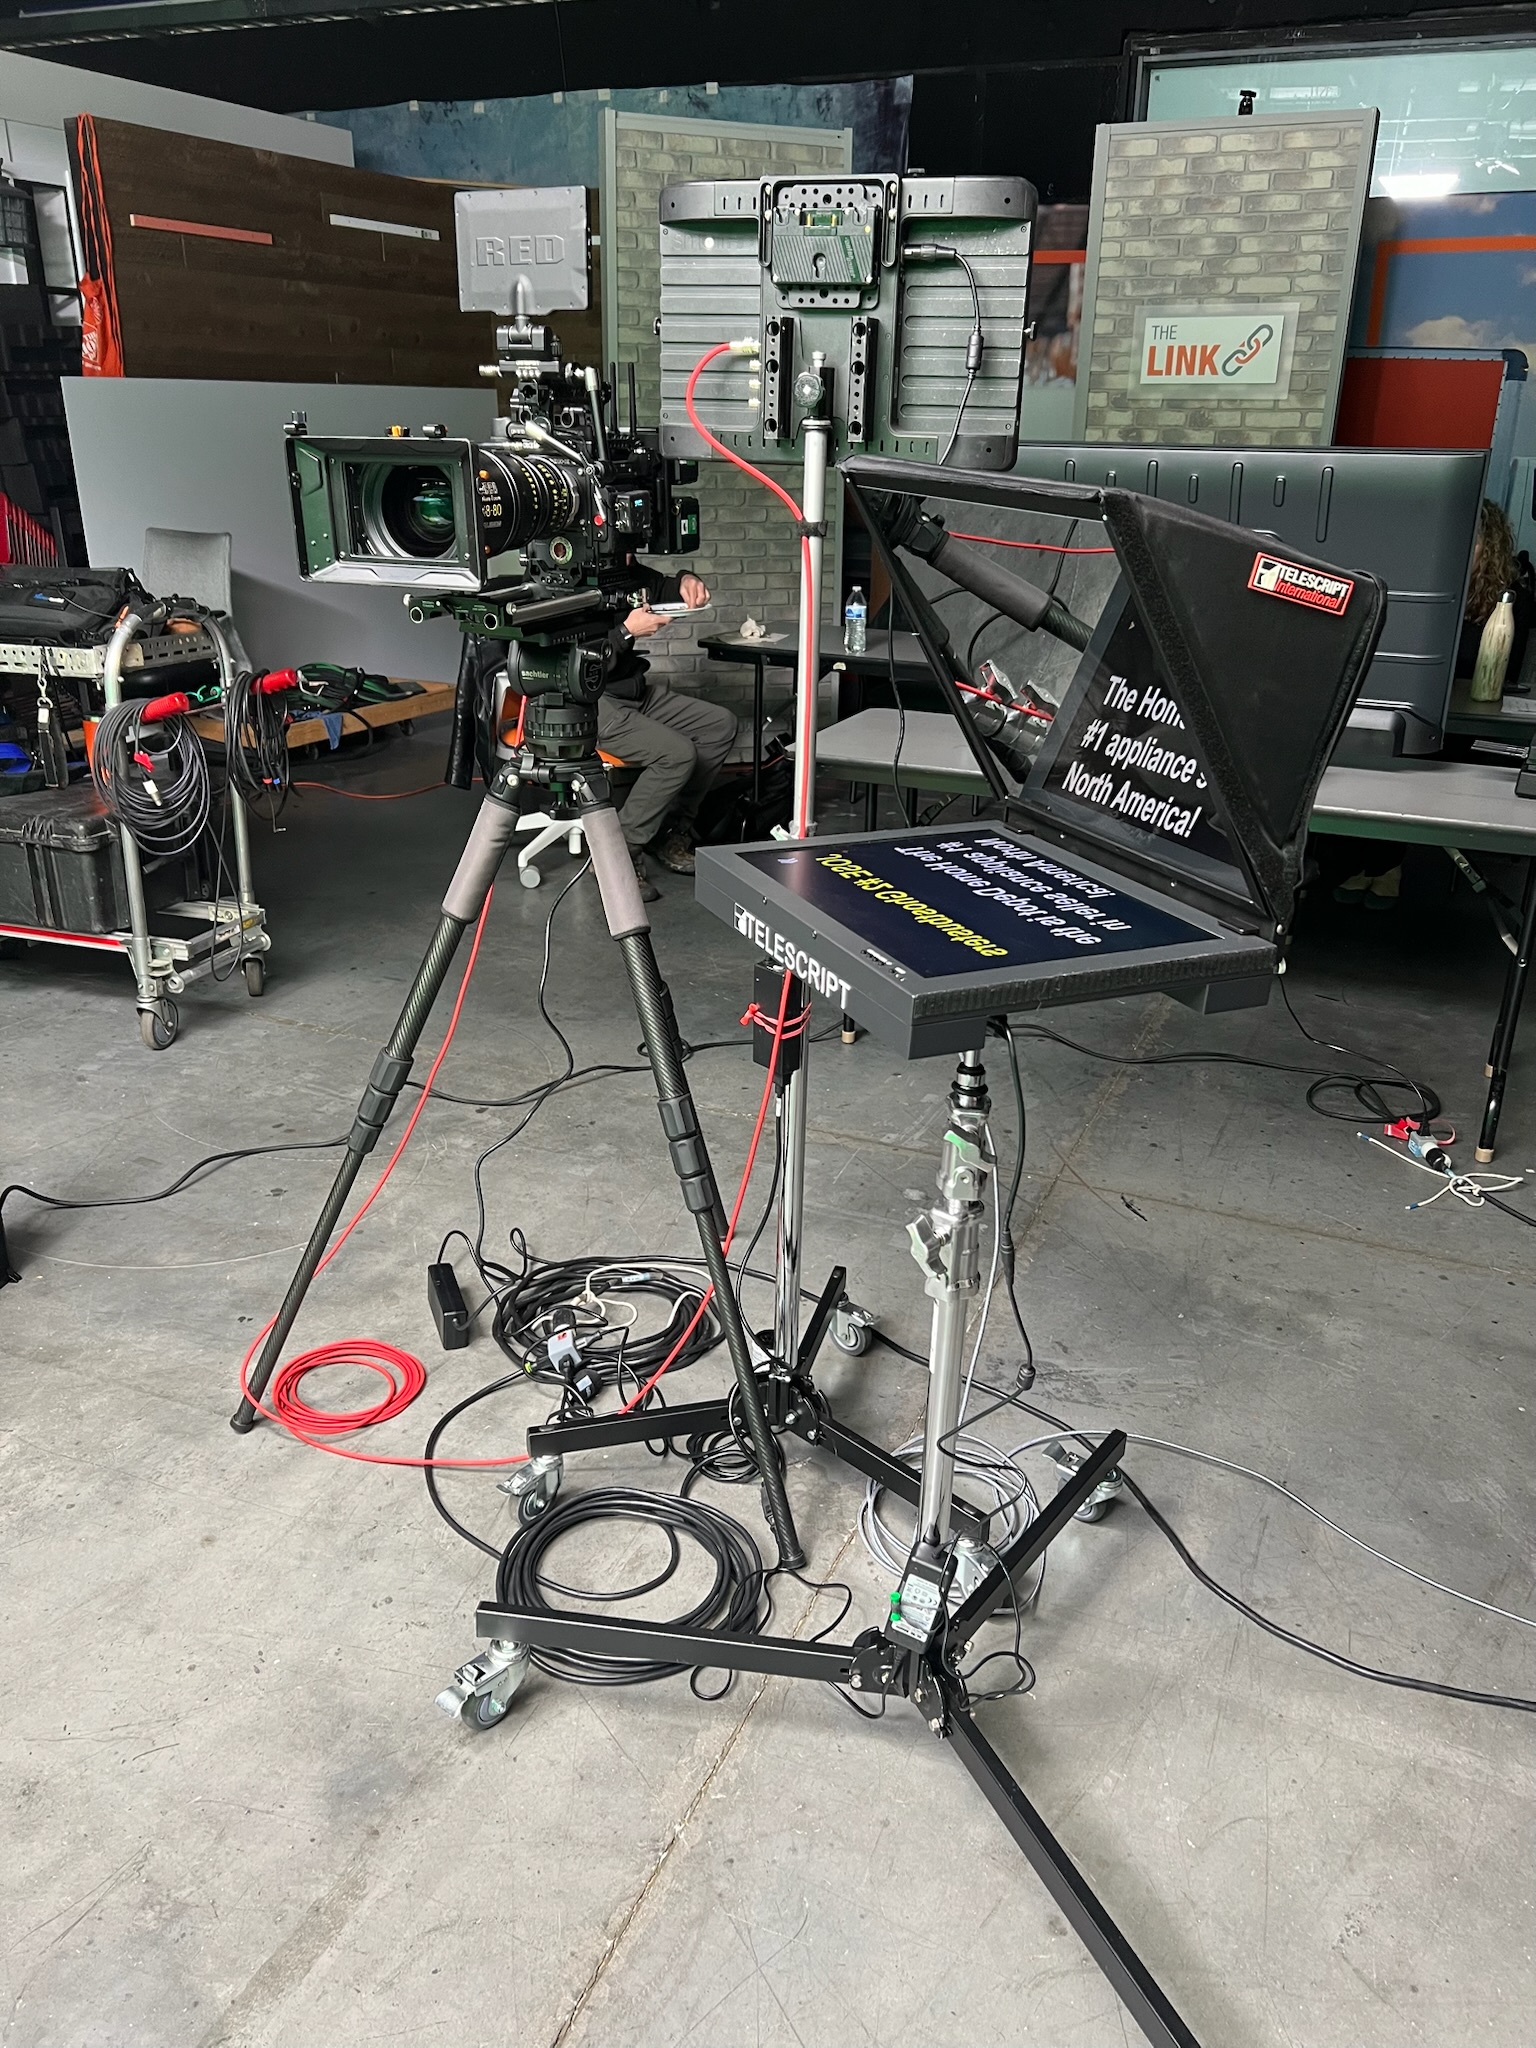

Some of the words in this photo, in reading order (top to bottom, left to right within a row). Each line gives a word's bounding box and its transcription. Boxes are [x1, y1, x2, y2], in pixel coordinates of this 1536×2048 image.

[476, 235, 564, 266] RED
[1152, 325, 1178, 340] THE
[1147, 345, 1221, 376] LINK
[1274, 579, 1342, 609] International
[1279, 564, 1349, 597] TELESCRIPT
[1103, 675, 1138, 712] The
[1136, 686, 1186, 730] Hom
[1080, 719, 1109, 751] #1
[1105, 733, 1197, 783] appliance
[1062, 761, 1113, 806] North
[1110, 780, 1202, 838] America!
[746, 911, 851, 1010] TELESCRIPT
